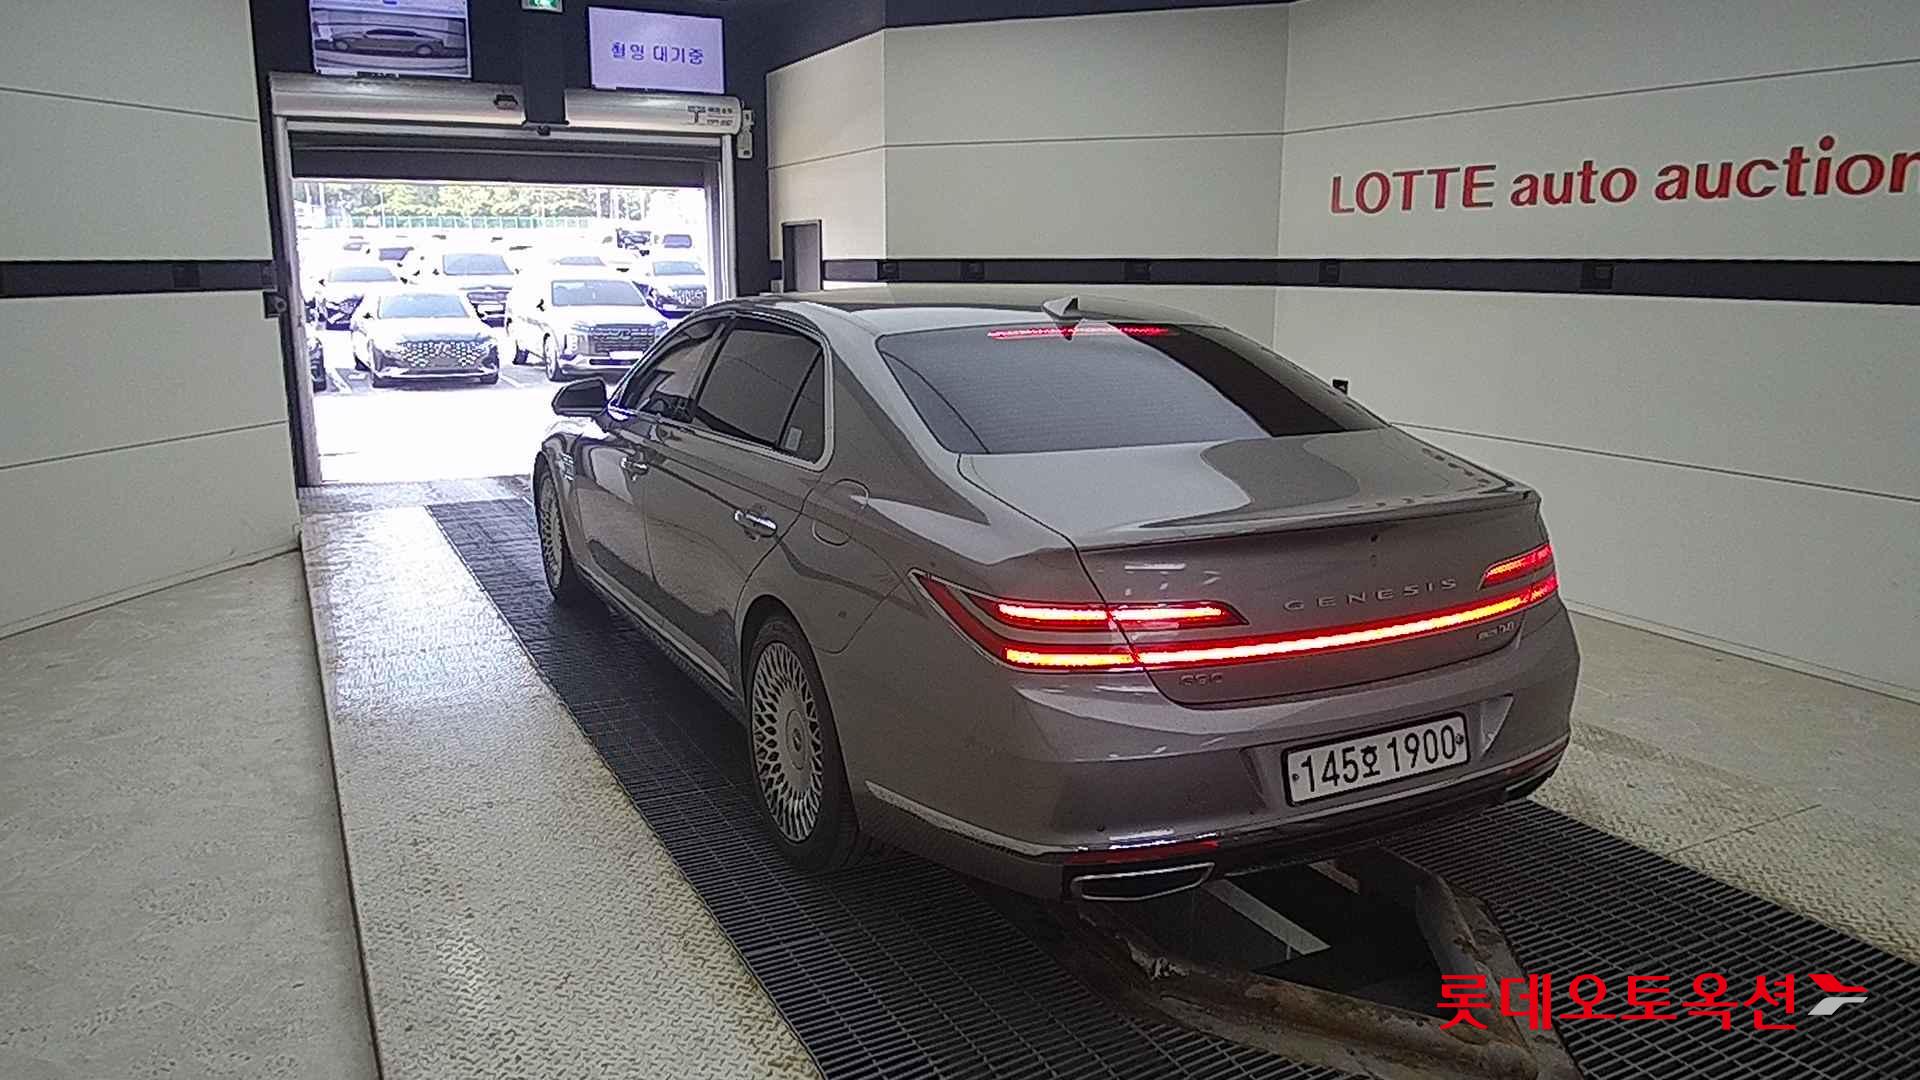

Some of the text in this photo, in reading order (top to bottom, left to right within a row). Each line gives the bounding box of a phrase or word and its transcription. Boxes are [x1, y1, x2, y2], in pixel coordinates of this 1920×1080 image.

[653, 44, 704, 65] 대기중
[1331, 163, 1497, 214] LOTTE
[1510, 159, 1637, 207] auto
[1283, 577, 1457, 612] GENESIS
[1301, 724, 1456, 793] 145호 1900
